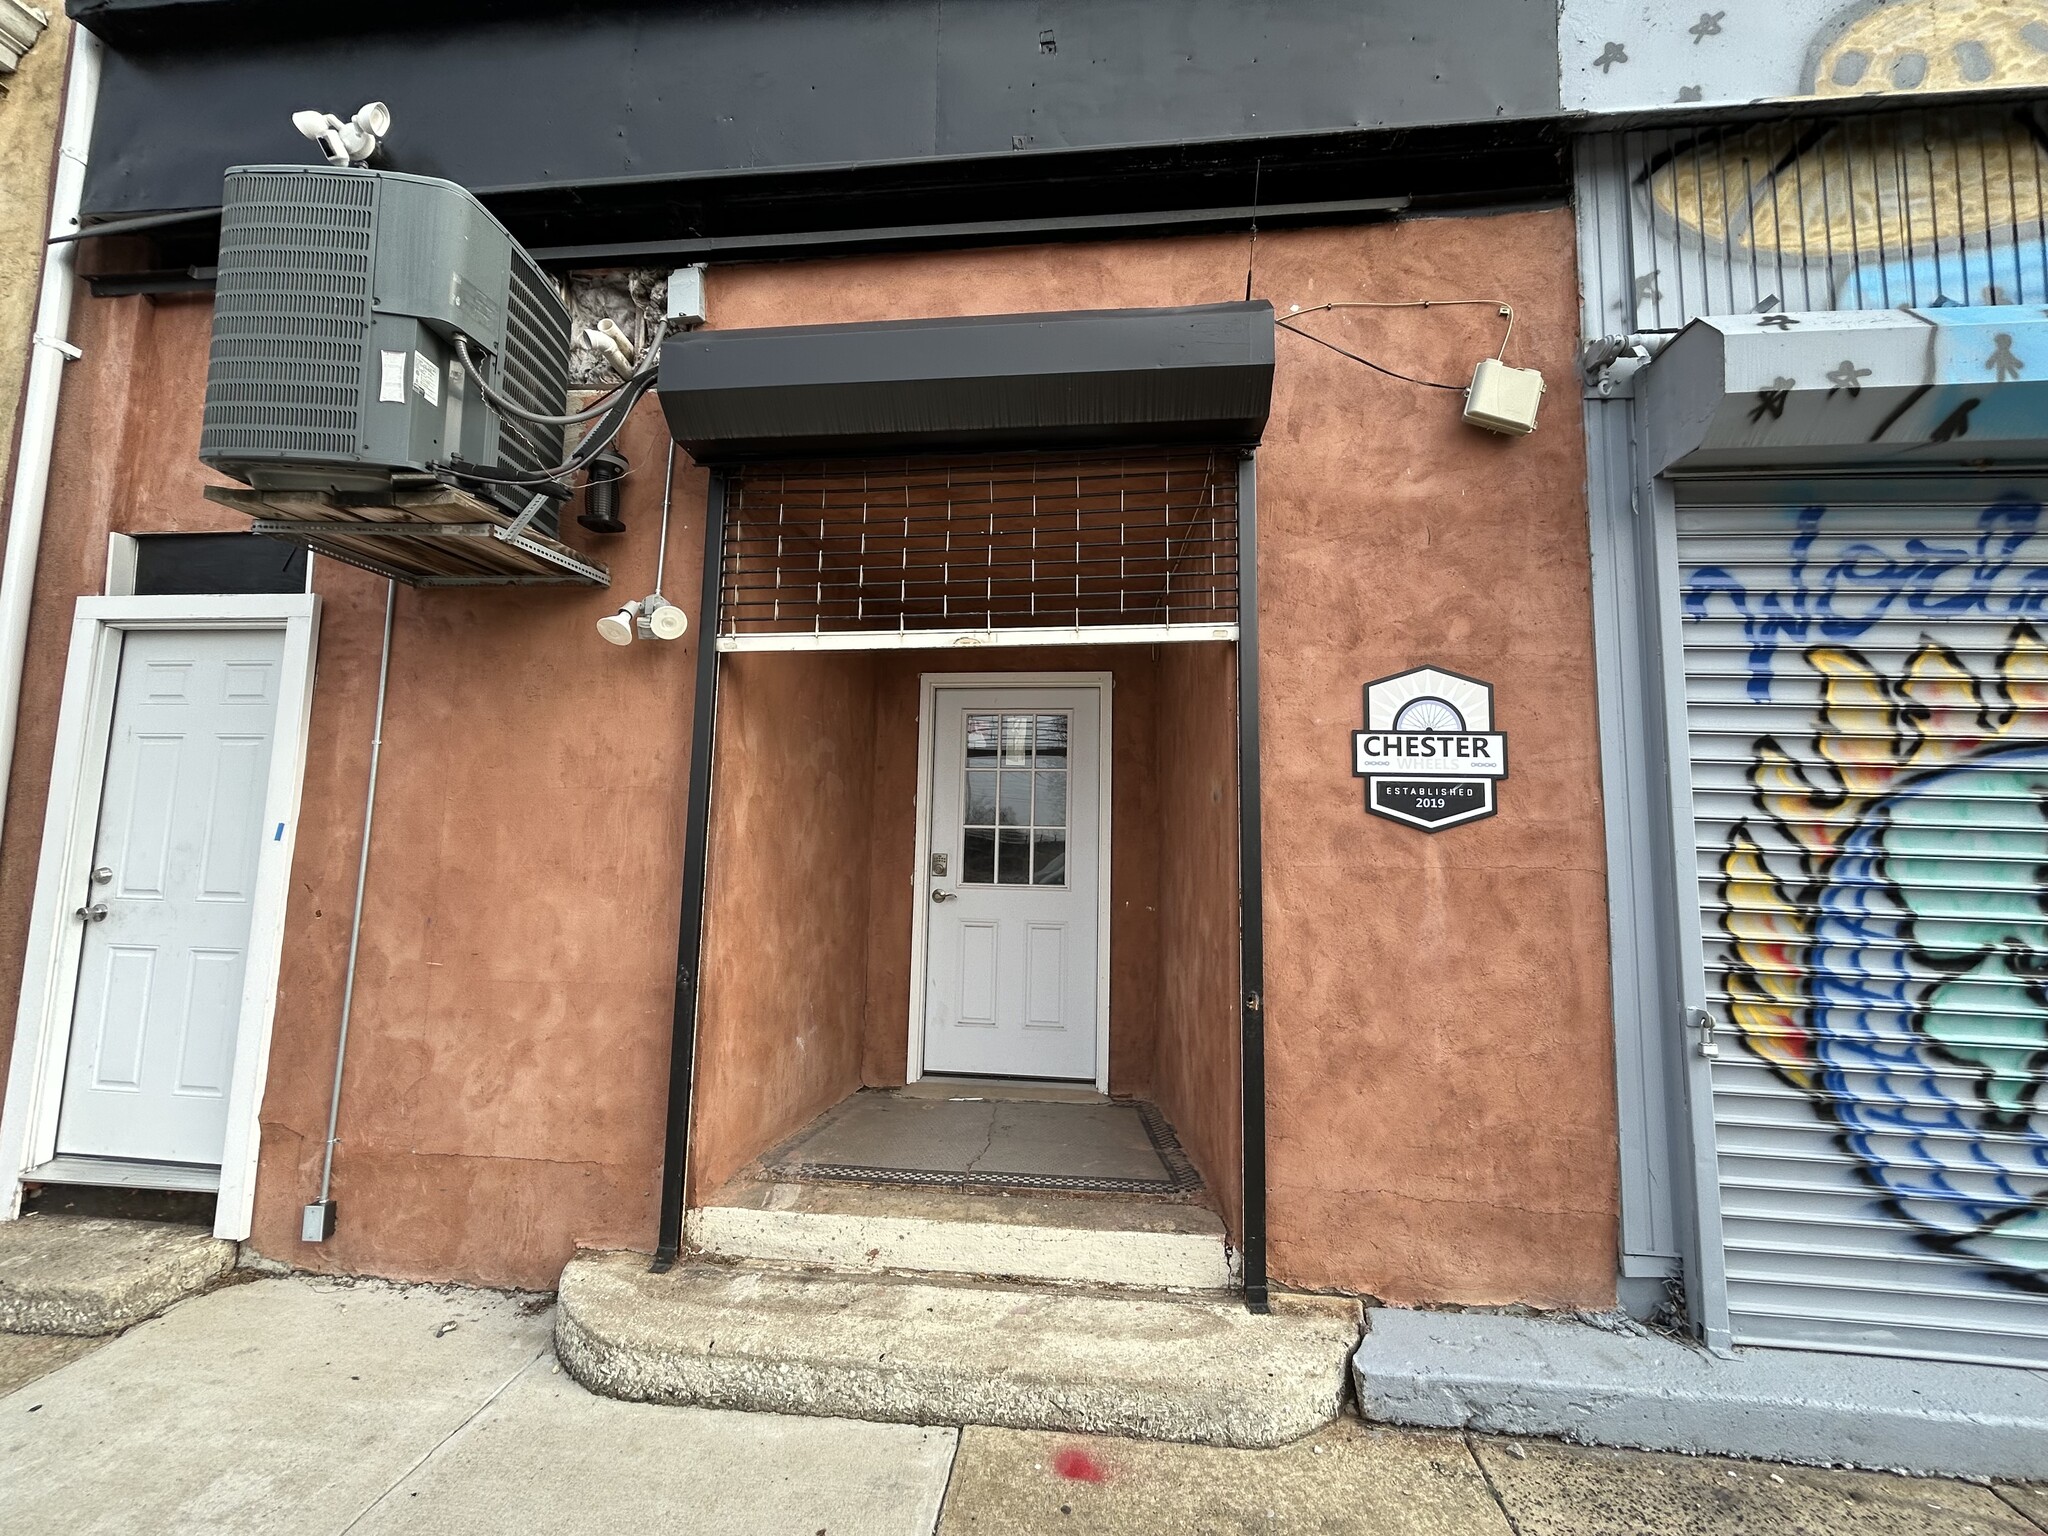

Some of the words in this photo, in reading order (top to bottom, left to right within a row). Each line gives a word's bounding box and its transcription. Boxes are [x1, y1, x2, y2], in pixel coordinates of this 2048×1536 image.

[1364, 736, 1491, 758] CHESTER
[1397, 758, 1460, 770] WHEELS
[1386, 787, 1473, 796] ESTABLISHED
[1415, 798, 1446, 808] 2019
